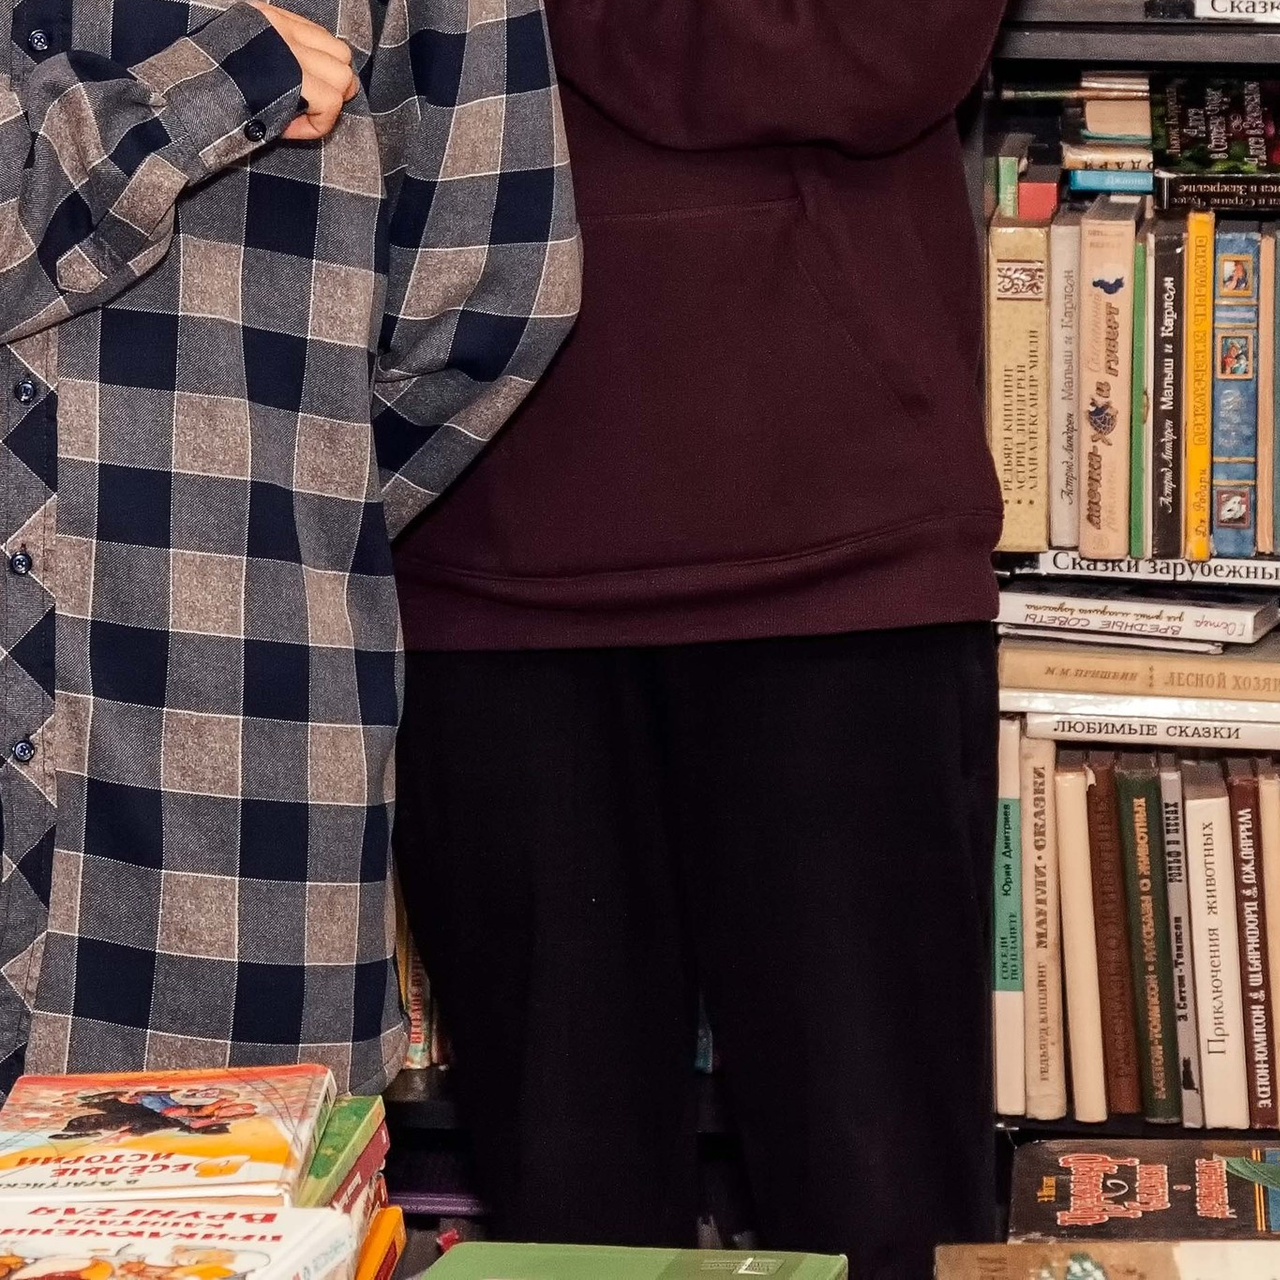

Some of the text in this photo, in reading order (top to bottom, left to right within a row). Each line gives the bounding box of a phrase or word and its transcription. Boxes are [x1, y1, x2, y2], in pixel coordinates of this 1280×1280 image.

[1178, 182, 1248, 195] Зазеркалье
[1061, 269, 1077, 329] Карлсон
[1193, 234, 1208, 326] ЧИПОЛЛИНО
[1028, 329, 1039, 370] МИЛН
[1061, 350, 1075, 401] Малыш
[1160, 276, 1177, 513] Астрид Линдгрен Малыш и Карлсон
[1193, 330, 1208, 446] ПРИКЛЮЧЕНИЯ
[1003, 364, 1013, 492] РЕДЬЯРД КИПЛИНГ
[1015, 364, 1026, 492] АСТРИД ЛИНДГРЕН
[1061, 411, 1078, 460] Линдгрен
[1060, 460, 1078, 506] Астрид
[1052, 551, 1140, 574] Сказки
[1023, 613, 1091, 628] СОВЕТЫ
[1100, 619, 1182, 636] ВРЕДНЫЕ
[1193, 614, 1237, 636] Остер
[1165, 671, 1228, 689] ЛЕСНОЙ
[1053, 720, 1242, 740] ЛЮБИМЫЕ СКАЗКИ
[1033, 764, 1047, 852] СКАЗКИ
[1001, 803, 1013, 897] Юрий Дмитриев
[1133, 797, 1152, 876] ЖИВОТНЫХ
[1166, 850, 1183, 884] РОЛЬФ
[1035, 863, 1048, 949] МАУГЛИ
[1201, 821, 1230, 1056] Приключения животных
[1174, 916, 1188, 1011] Сетон-Томпсон
[15, 1151, 176, 1168] ИСТОРИИ
[50, 1154, 251, 1179] ВЕСЁЛЫЕ
[27, 1206, 279, 1225] ВРУНГЕЛЯ
[53, 1218, 226, 1230] КАПИТАНА
